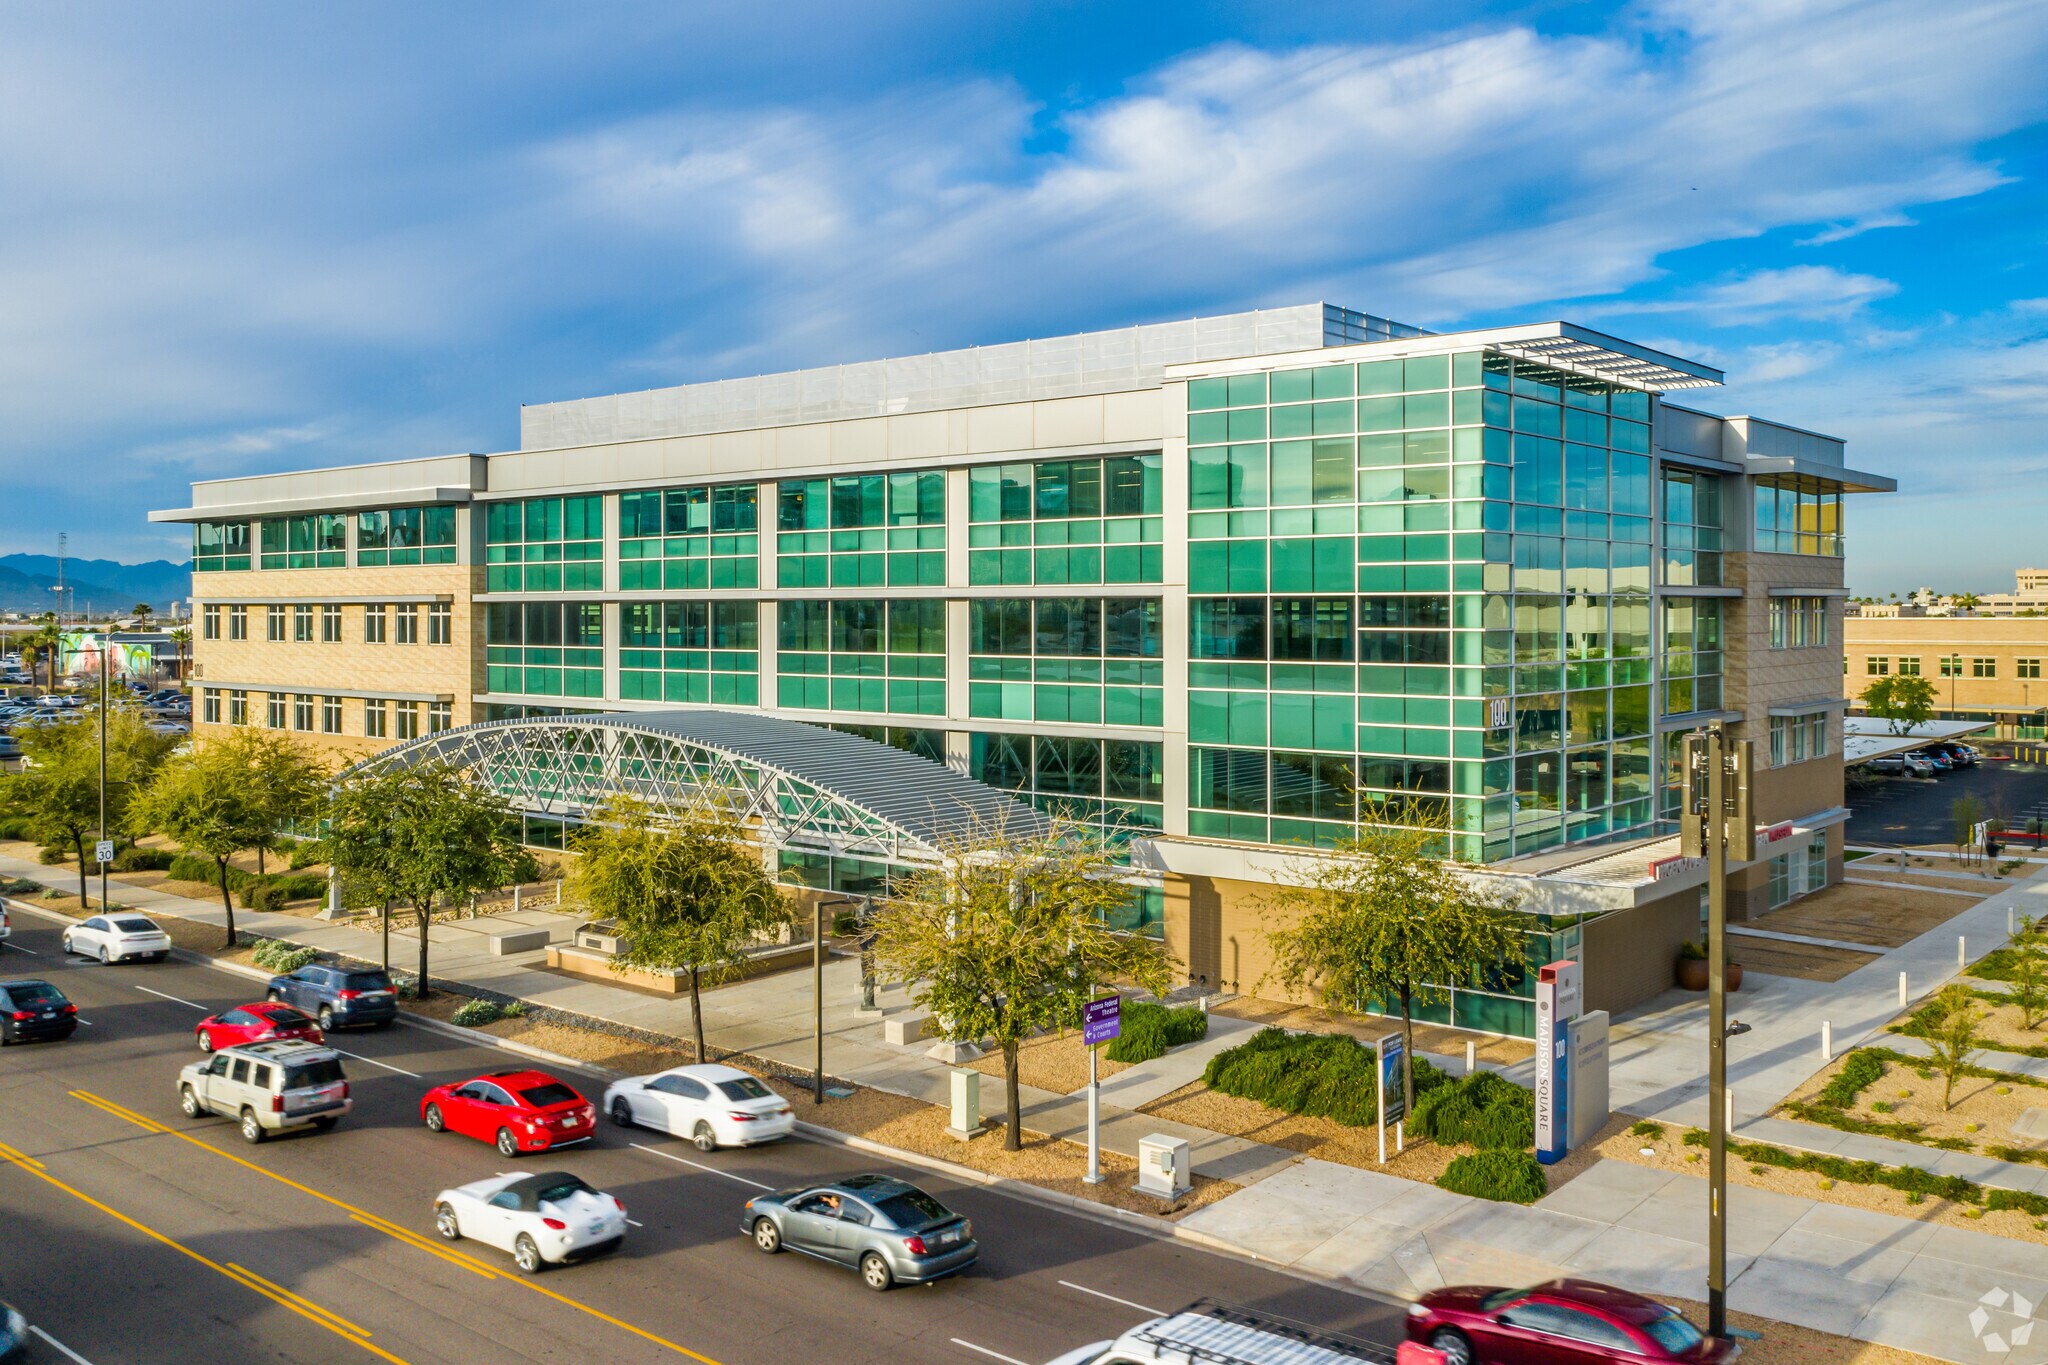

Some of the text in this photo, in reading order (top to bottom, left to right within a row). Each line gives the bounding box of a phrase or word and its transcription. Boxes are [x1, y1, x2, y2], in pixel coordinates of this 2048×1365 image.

[194, 663, 204, 678] 100
[1490, 699, 1506, 727] 100
[98, 850, 112, 861] 30
[1090, 998, 1118, 1012] Arizona Federal
[1102, 1007, 1118, 1016] Theatre
[1093, 1019, 1119, 1032] Government
[1097, 1030, 1111, 1039] Courts
[1555, 1039, 1566, 1059] 100
